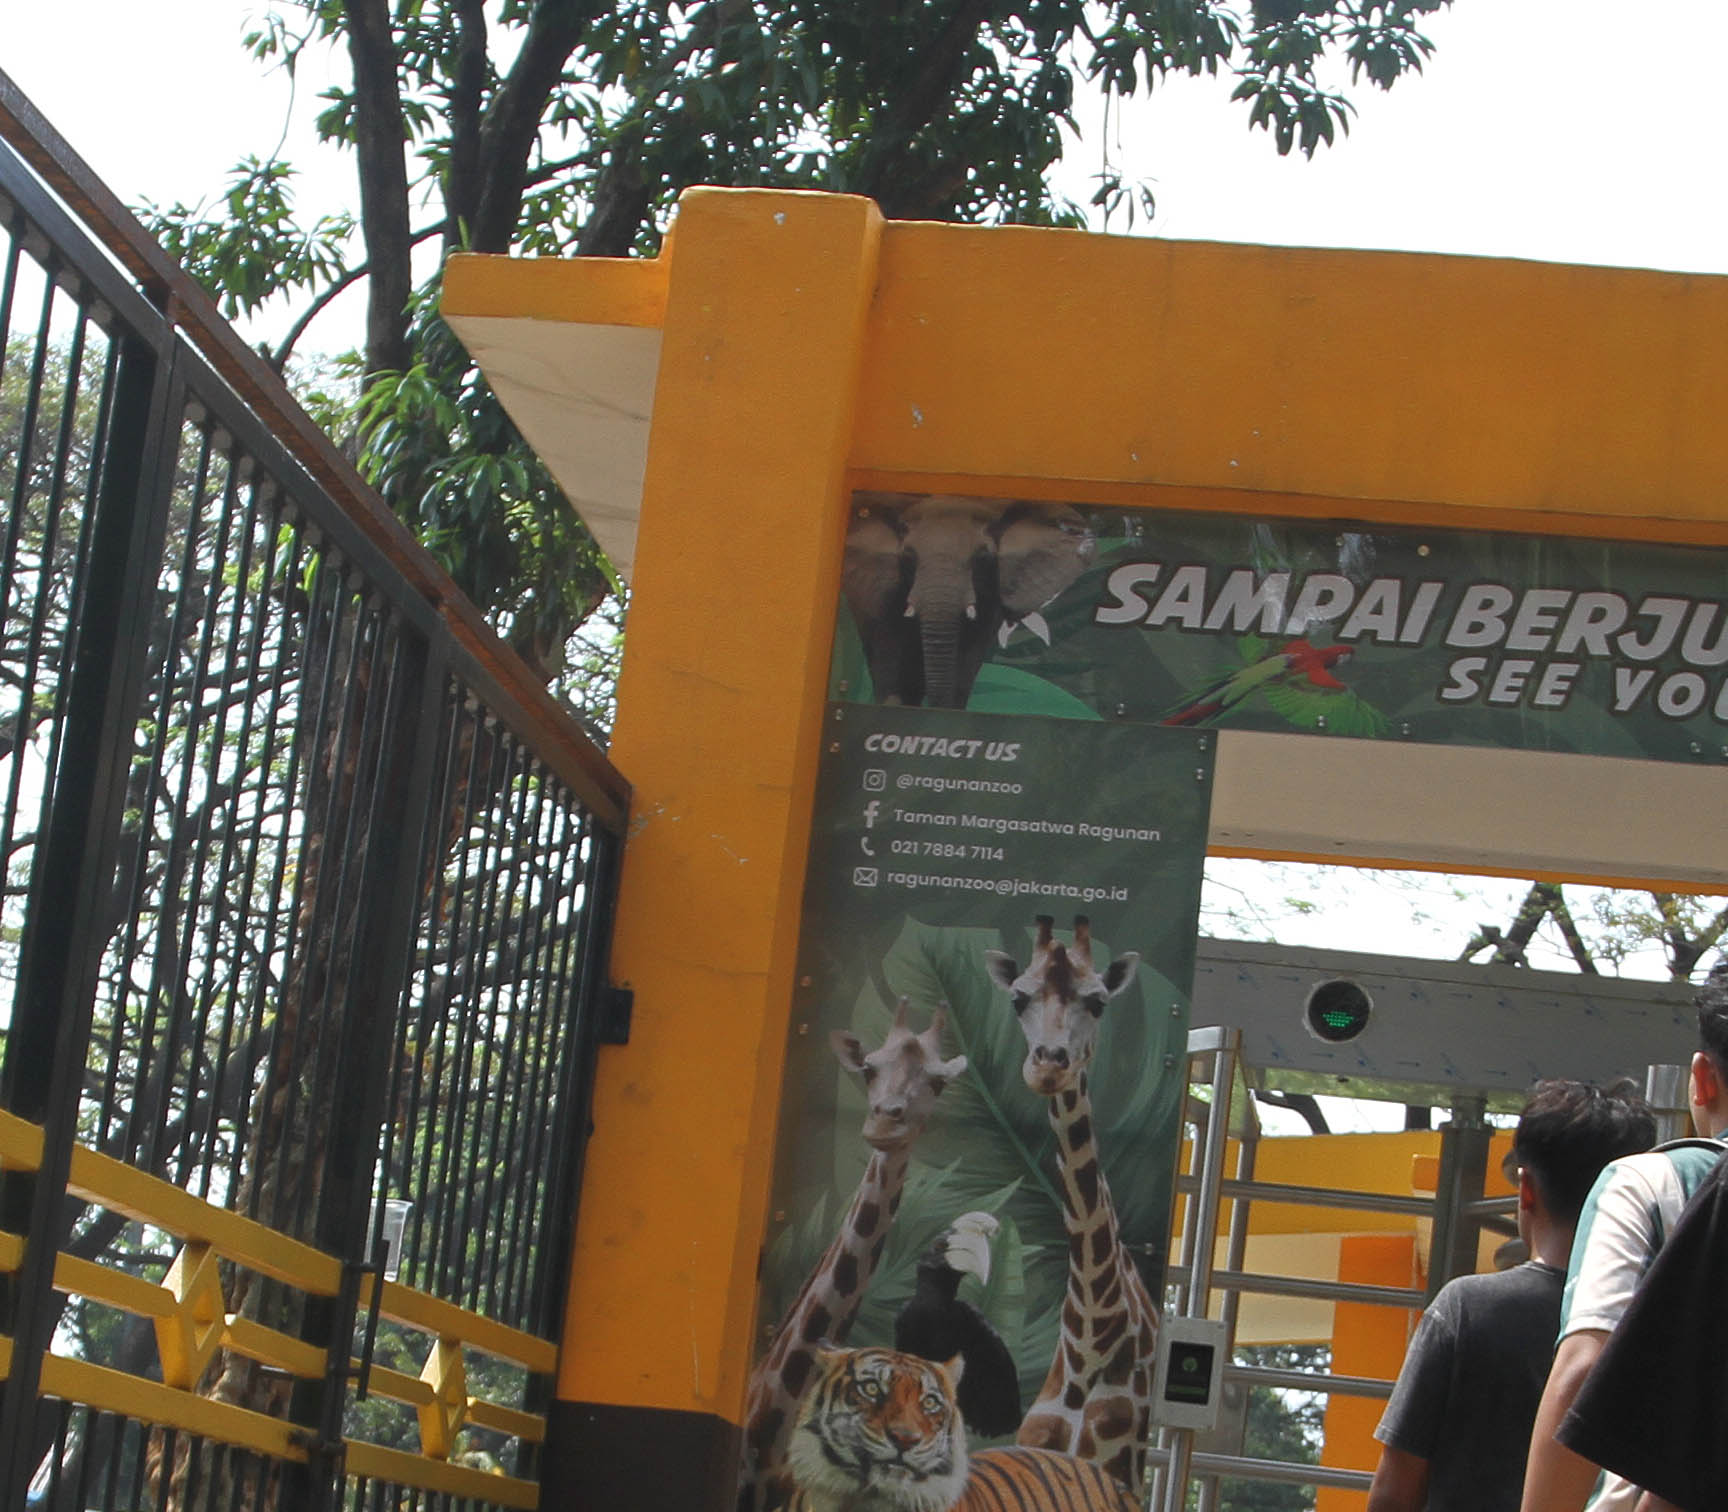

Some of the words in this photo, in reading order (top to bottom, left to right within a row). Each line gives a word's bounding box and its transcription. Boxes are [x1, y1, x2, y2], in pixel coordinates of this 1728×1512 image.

[1095, 562, 1444, 645] SAMPAI
[1441, 656, 1578, 706] SEE
[864, 733, 982, 758] CONTACT
[984, 742, 1021, 761] US
[896, 774, 1022, 794] @ragunanzoo
[894, 809, 956, 826] Taman
[961, 814, 1074, 834] Margasatwa
[1078, 823, 1160, 842] Ragunan
[891, 840, 918, 854] 021
[923, 842, 966, 857] 7884
[971, 846, 1004, 861] 7114
[887, 871, 1128, 902] ragunanzoo@jakarta.go.id
